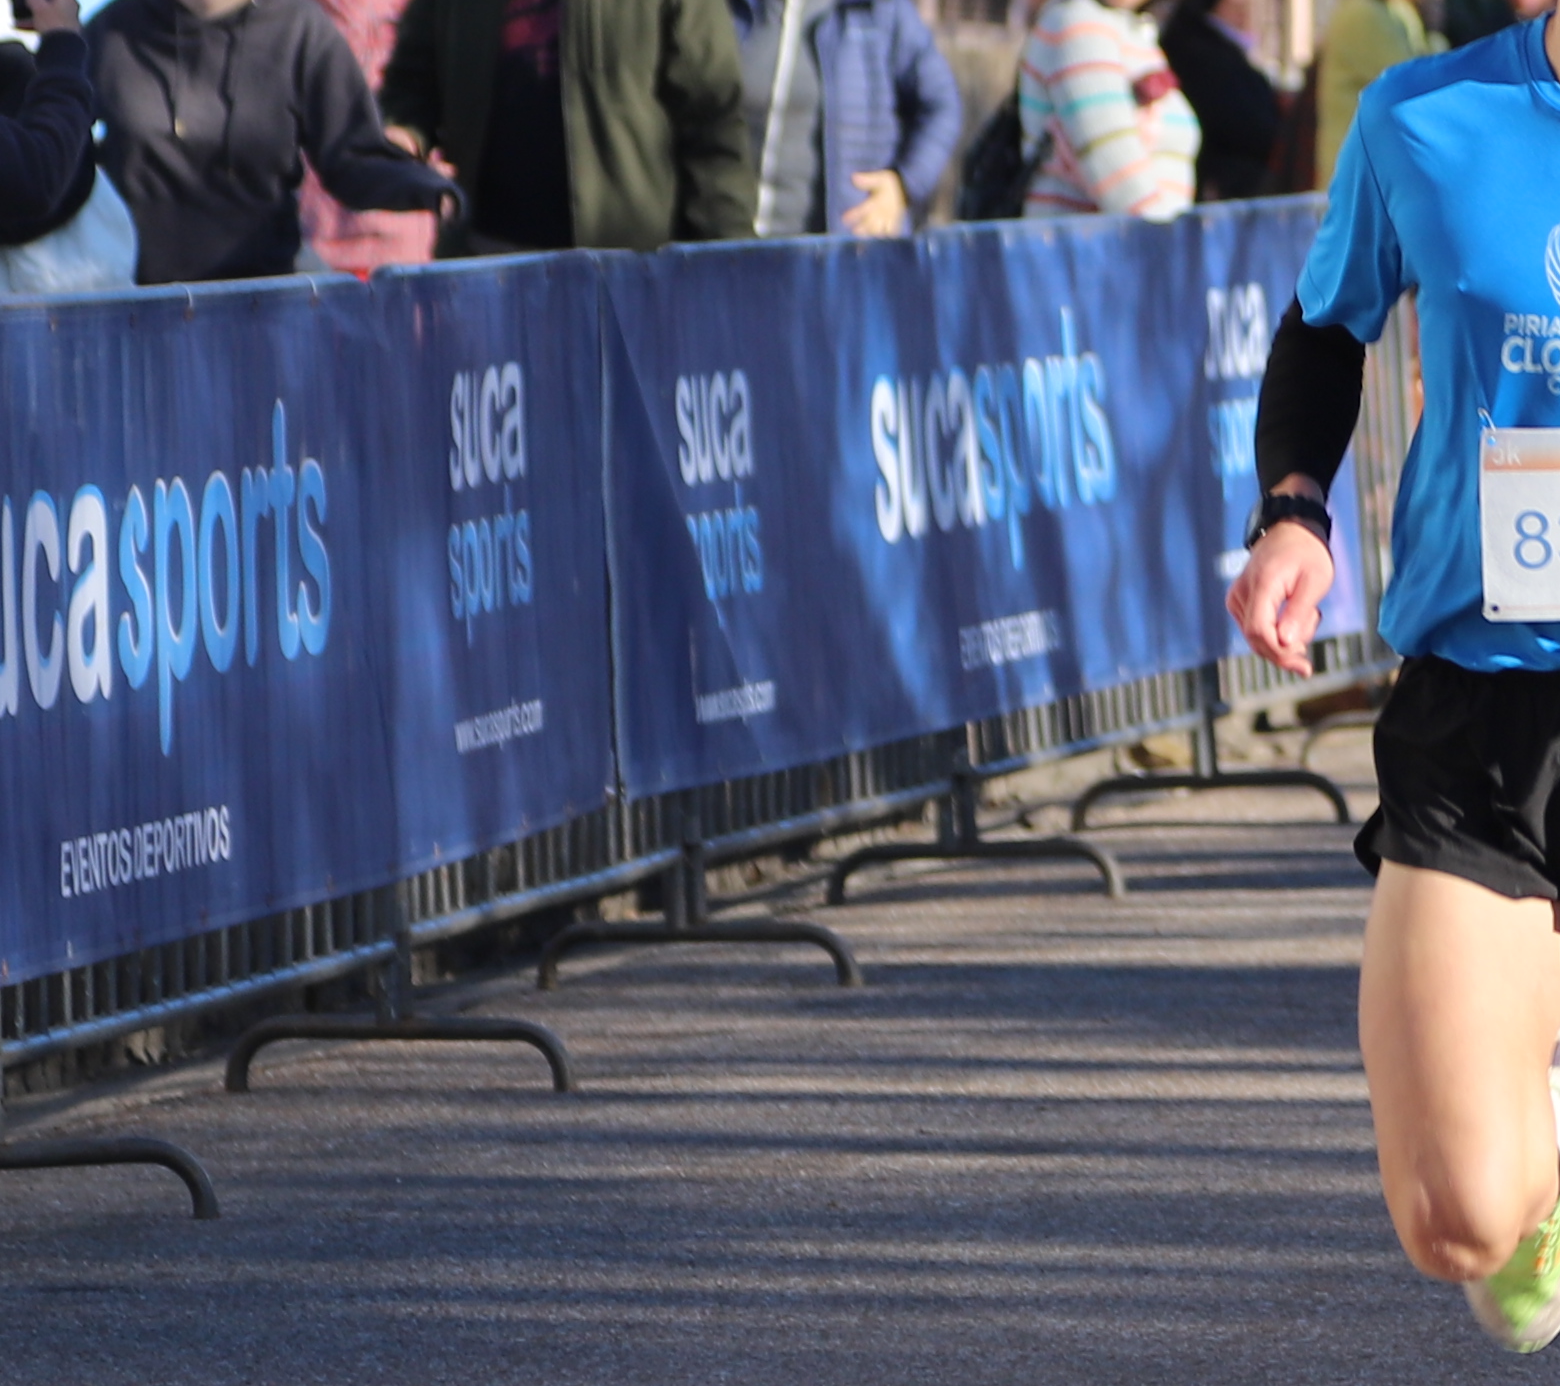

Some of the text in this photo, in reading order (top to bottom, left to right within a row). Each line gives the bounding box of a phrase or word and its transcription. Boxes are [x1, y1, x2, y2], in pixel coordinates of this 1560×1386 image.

[450, 360, 527, 492] suca
[675, 368, 754, 487] suca
[447, 481, 532, 649] sports
[60, 804, 231, 898] EVENTOS DEPORTIVOS
